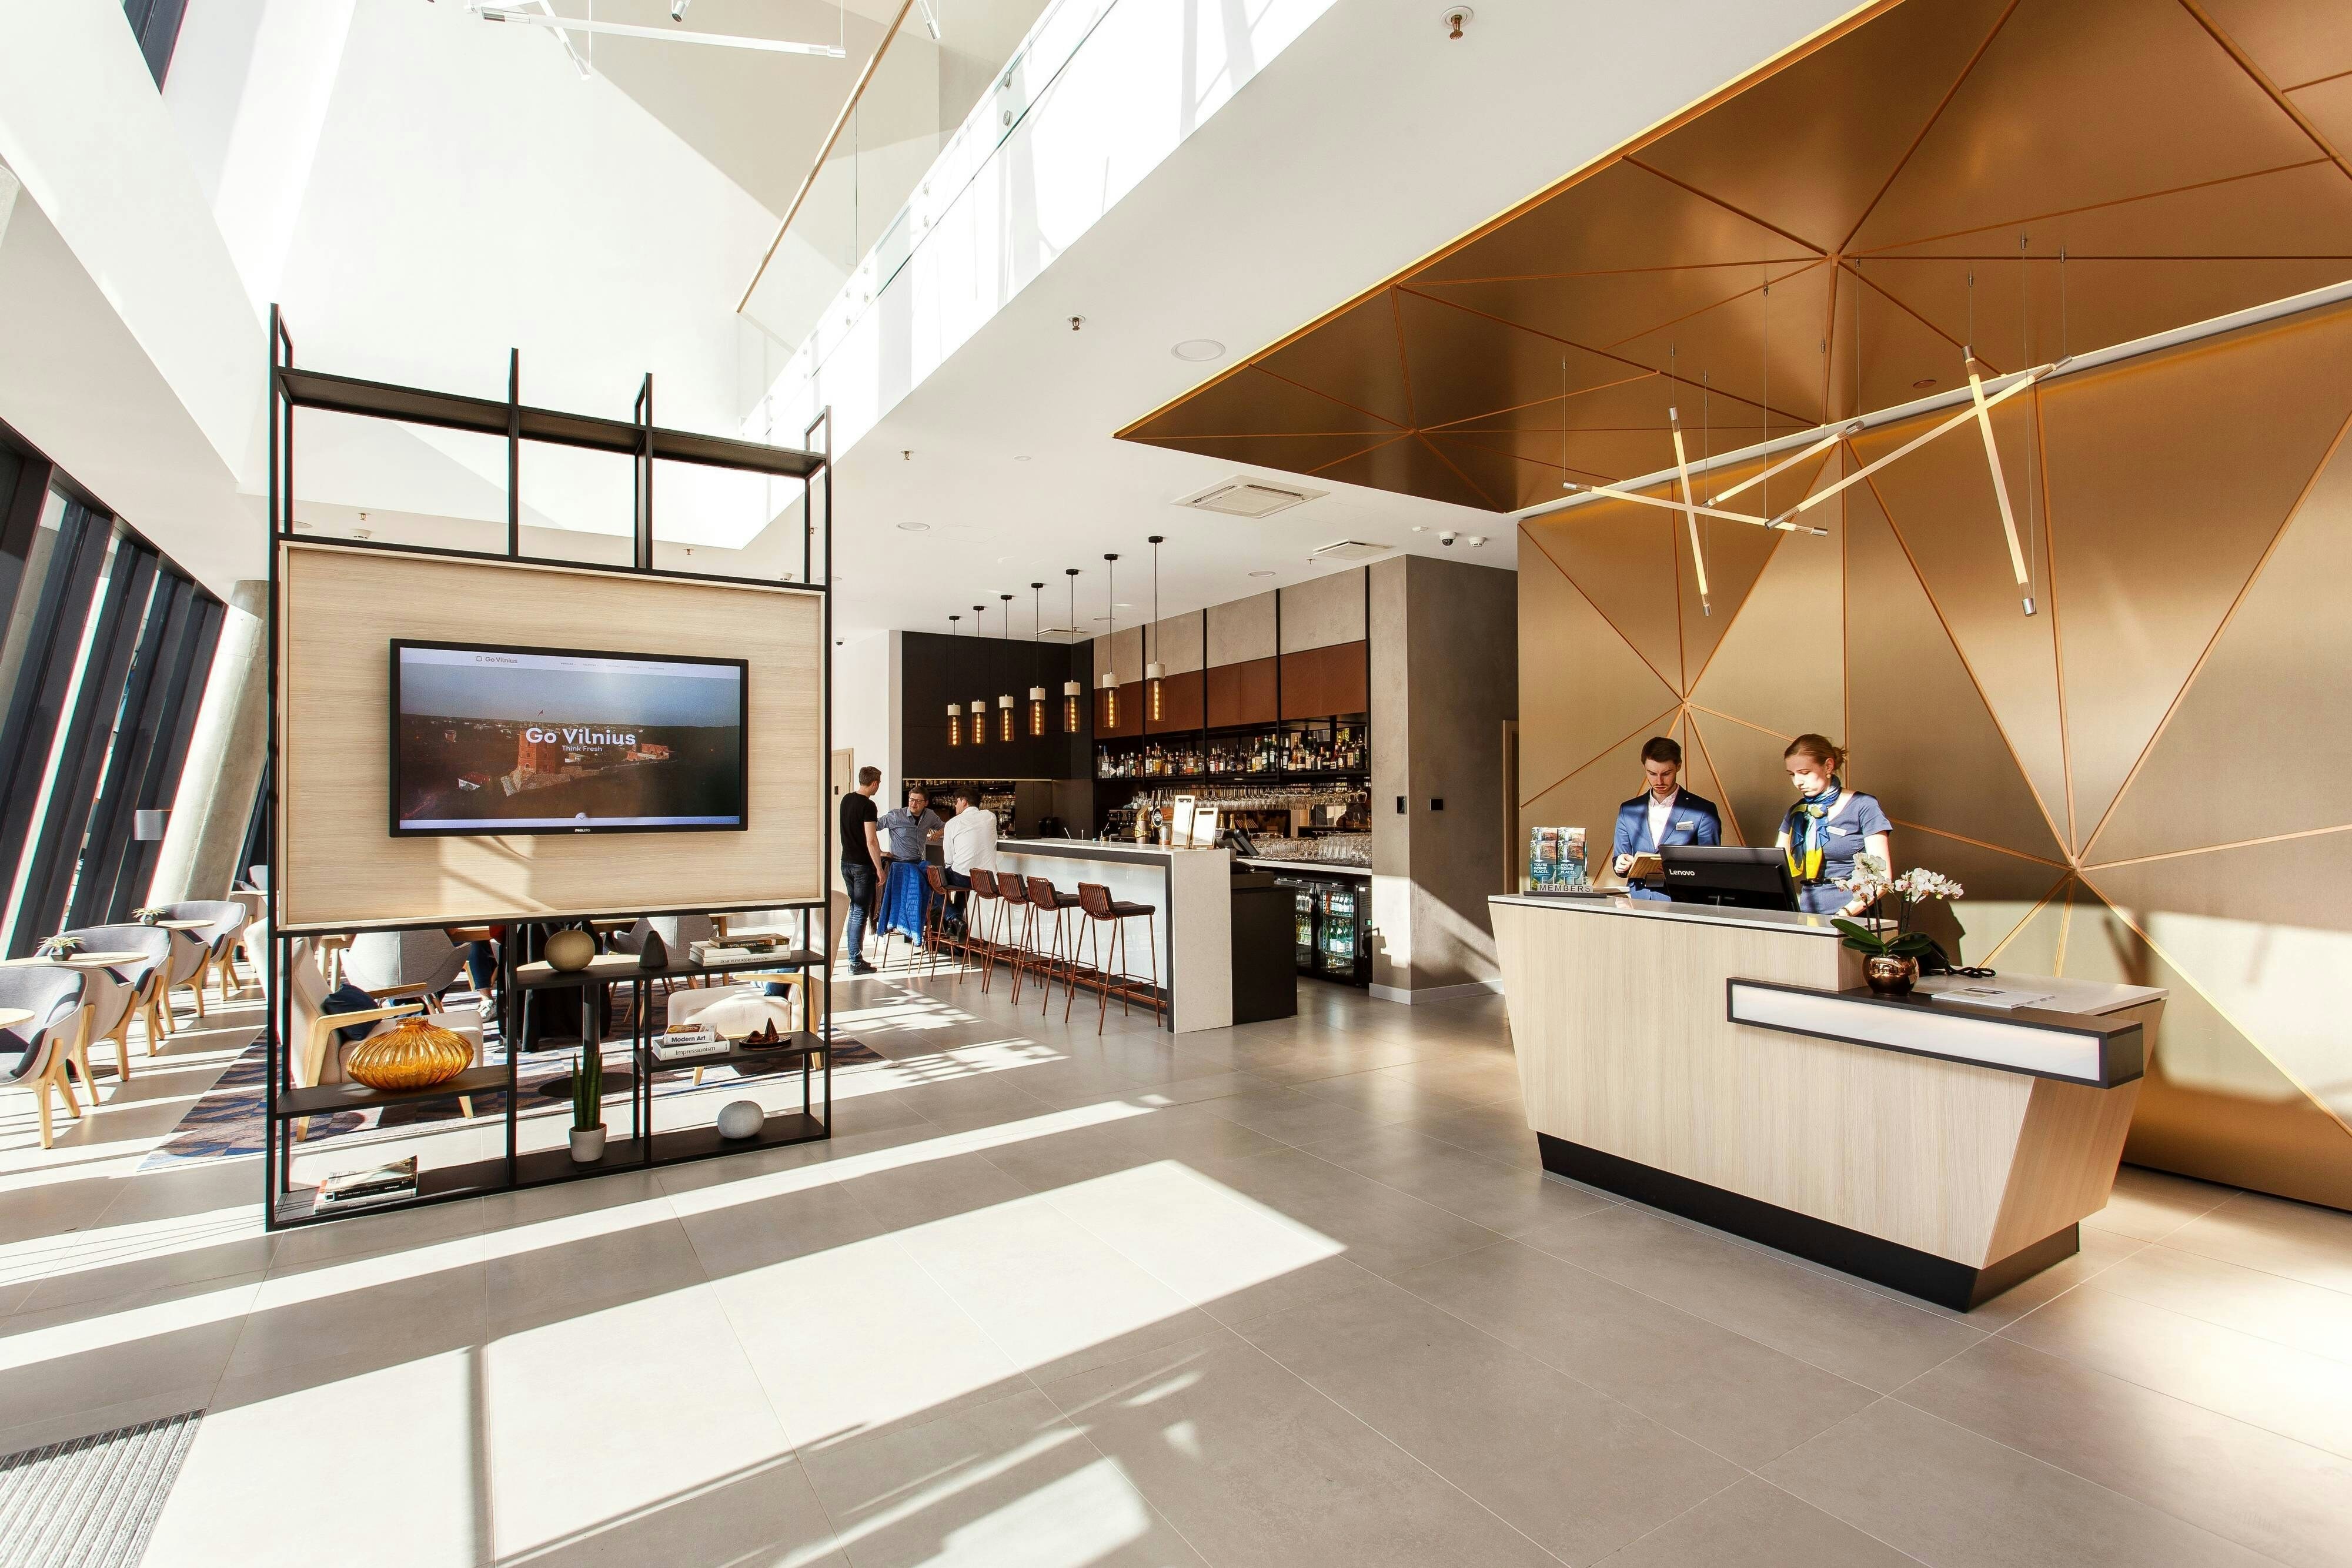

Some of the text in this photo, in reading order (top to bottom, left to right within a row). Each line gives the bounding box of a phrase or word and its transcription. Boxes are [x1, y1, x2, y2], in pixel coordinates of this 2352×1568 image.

[526, 727, 636, 745] Go Vilnius
[675, 1045, 716, 1056] Impressionism
